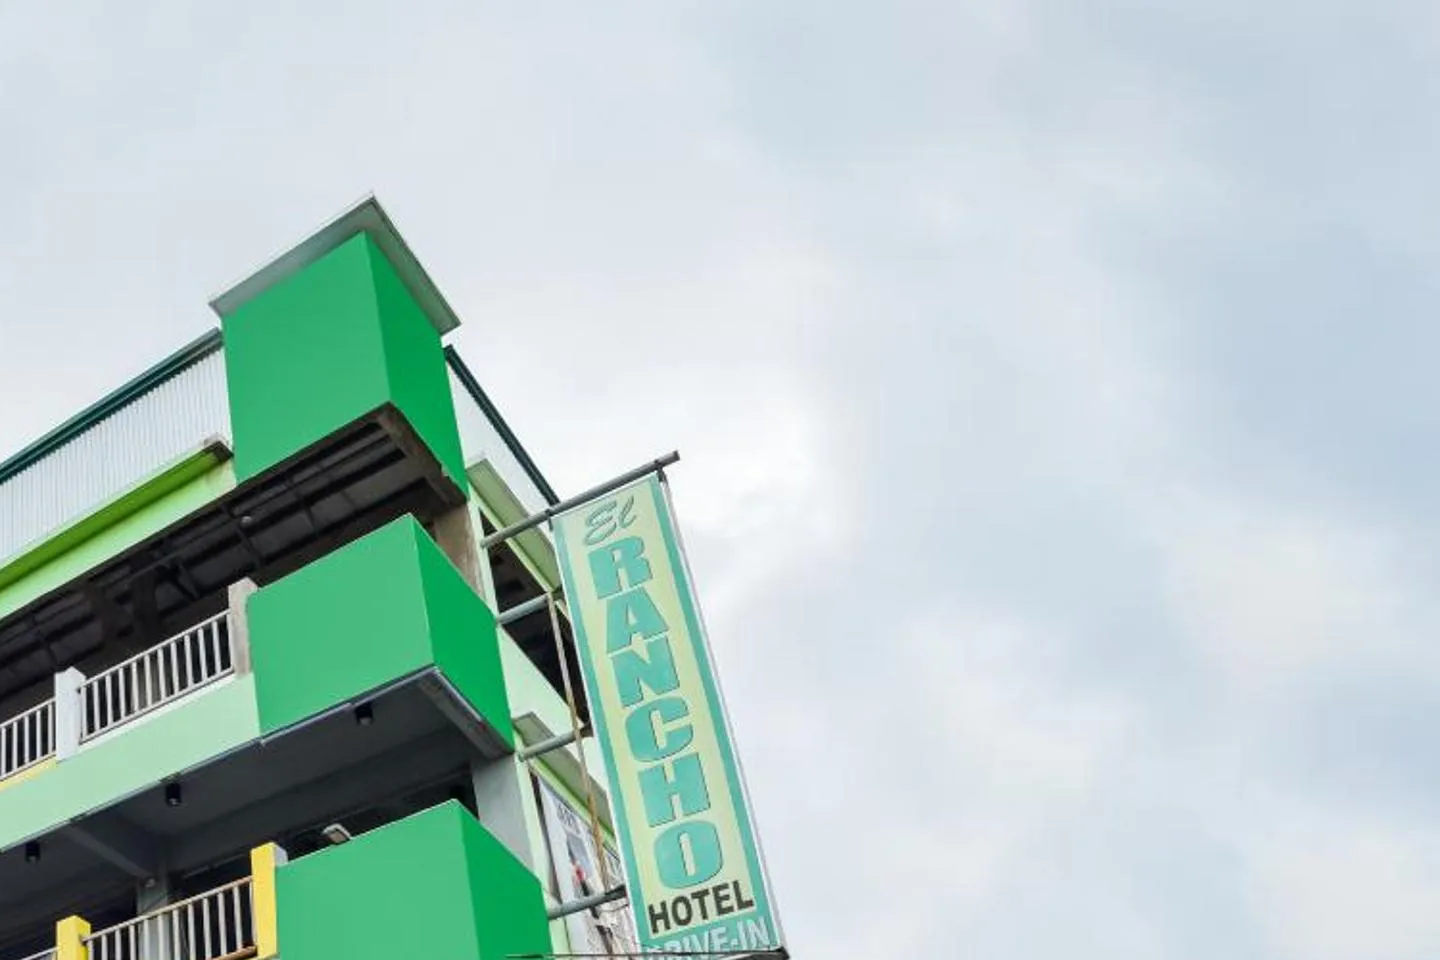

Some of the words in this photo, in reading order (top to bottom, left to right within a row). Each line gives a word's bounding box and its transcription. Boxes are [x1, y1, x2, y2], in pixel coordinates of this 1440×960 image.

[583, 496, 635, 546] El
[587, 535, 725, 890] RANCHO
[648, 880, 754, 934] HOTEL
